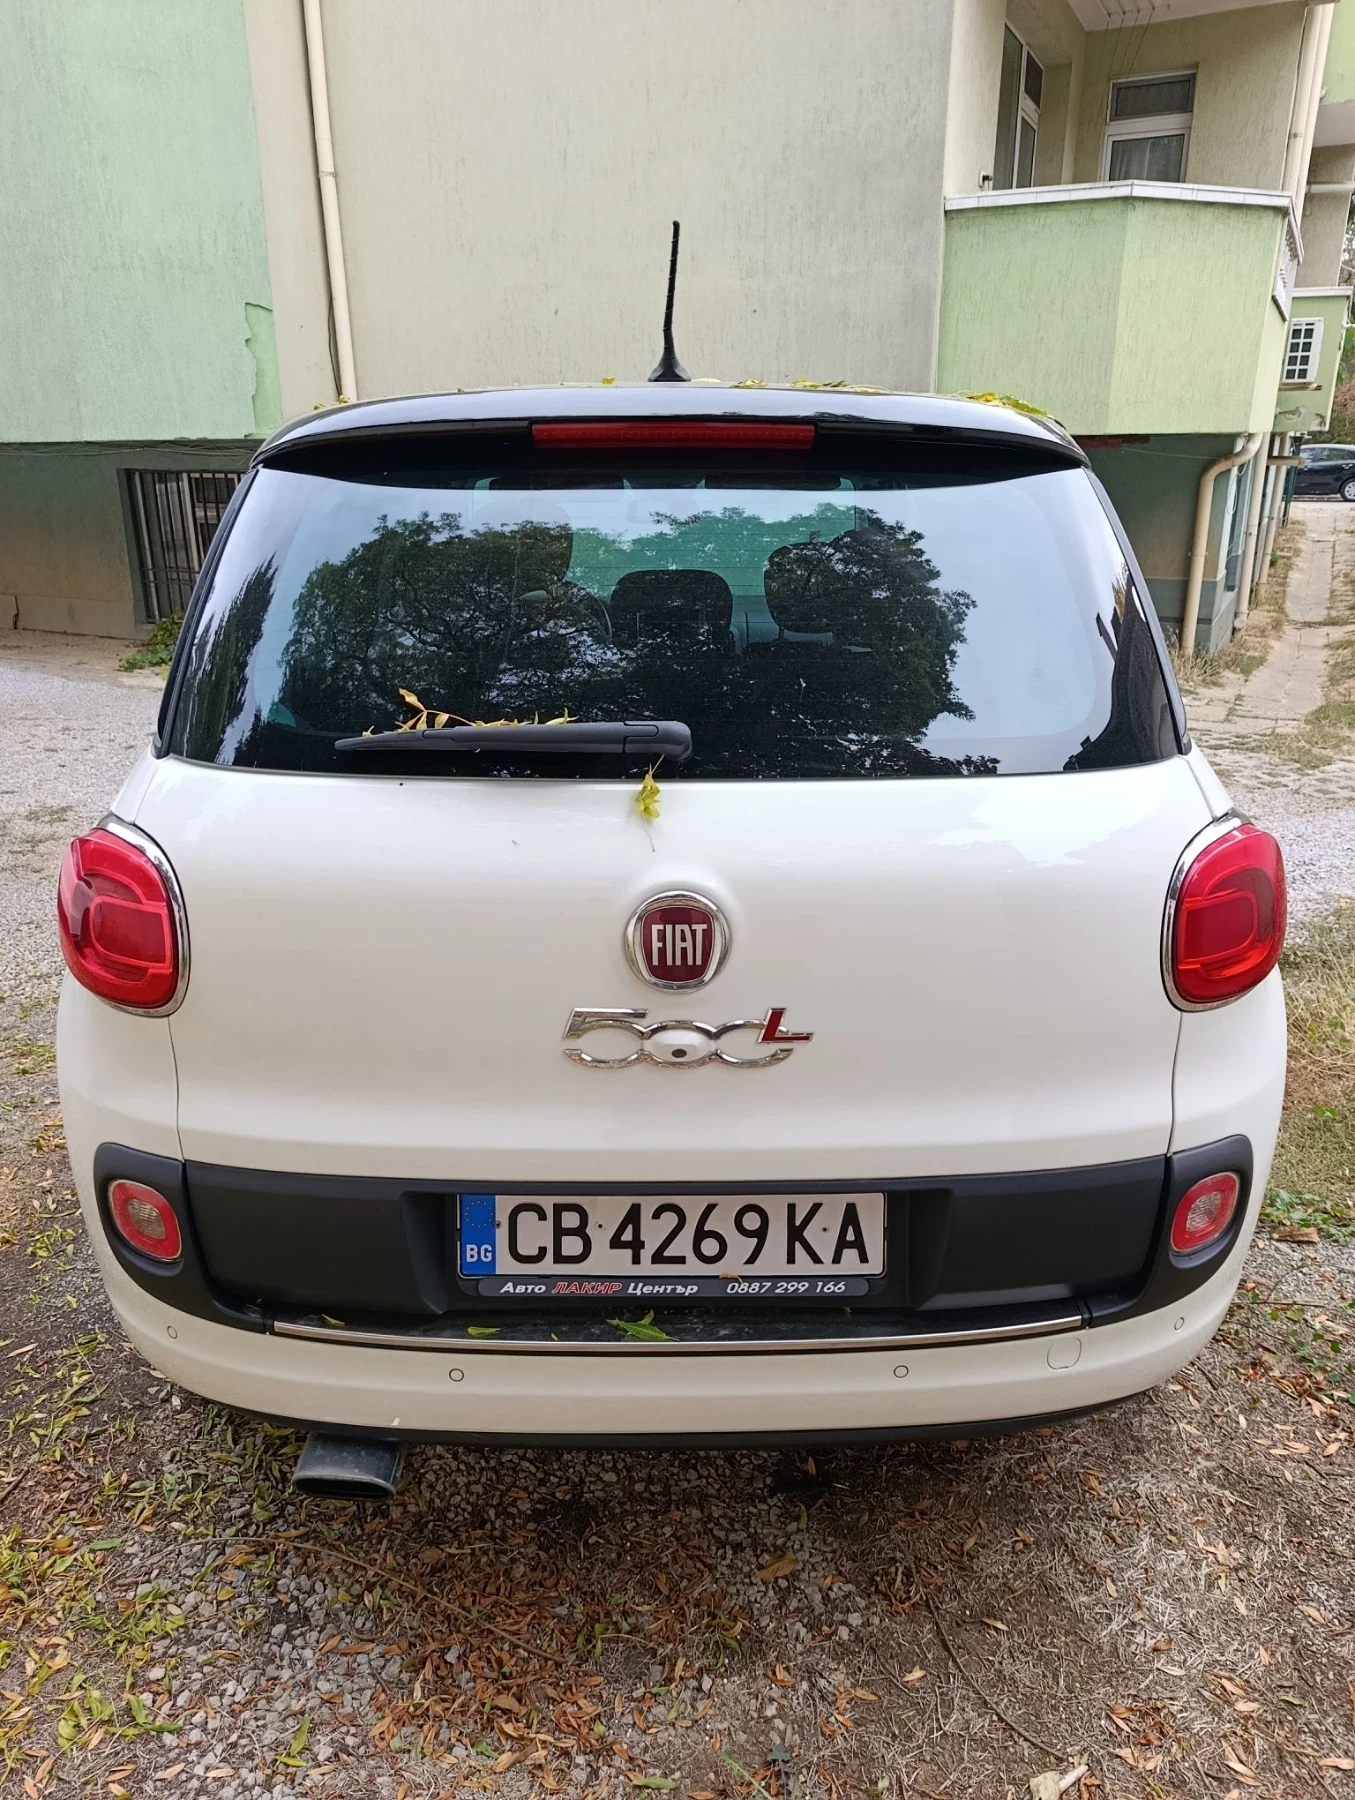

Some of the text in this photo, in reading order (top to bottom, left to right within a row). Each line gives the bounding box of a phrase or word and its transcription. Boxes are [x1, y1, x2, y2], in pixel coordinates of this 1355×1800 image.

[651, 924, 707, 966] FIAT
[466, 1244, 493, 1263] BG
[500, 1280, 846, 1296] Авто ЛАКИР Център 0887 299 166
